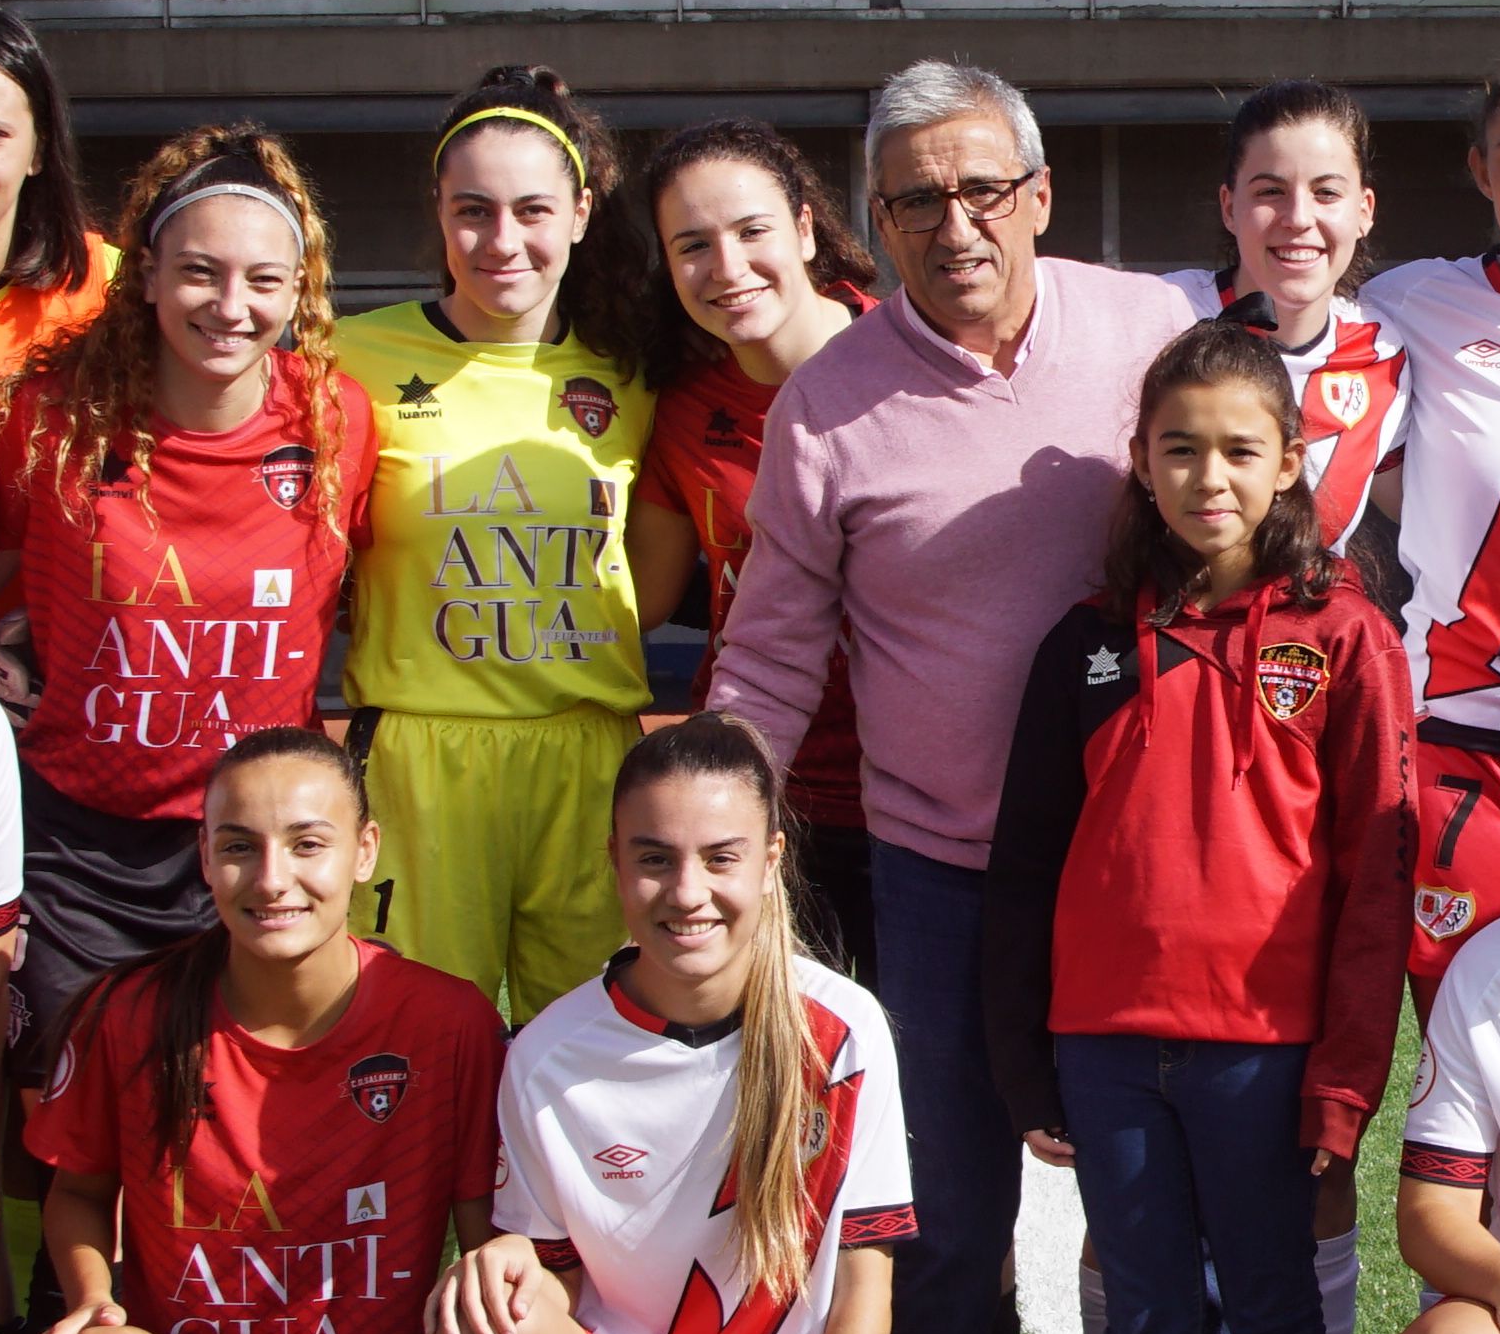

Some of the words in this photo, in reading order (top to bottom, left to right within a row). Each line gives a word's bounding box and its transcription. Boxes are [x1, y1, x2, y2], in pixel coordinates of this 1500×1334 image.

[397, 408, 443, 421] luanvi
[421, 454, 544, 516] LA
[83, 540, 203, 607] LA
[83, 616, 304, 680] ANTI-
[434, 599, 592, 662] GUA
[1087, 673, 1121, 685] luanvi
[84, 683, 238, 751] GUA
[1433, 773, 1483, 870] 7
[373, 878, 395, 934] 1
[165, 1167, 293, 1232] LA
[601, 1168, 645, 1180] umbro
[168, 1234, 412, 1306] ANTI-
